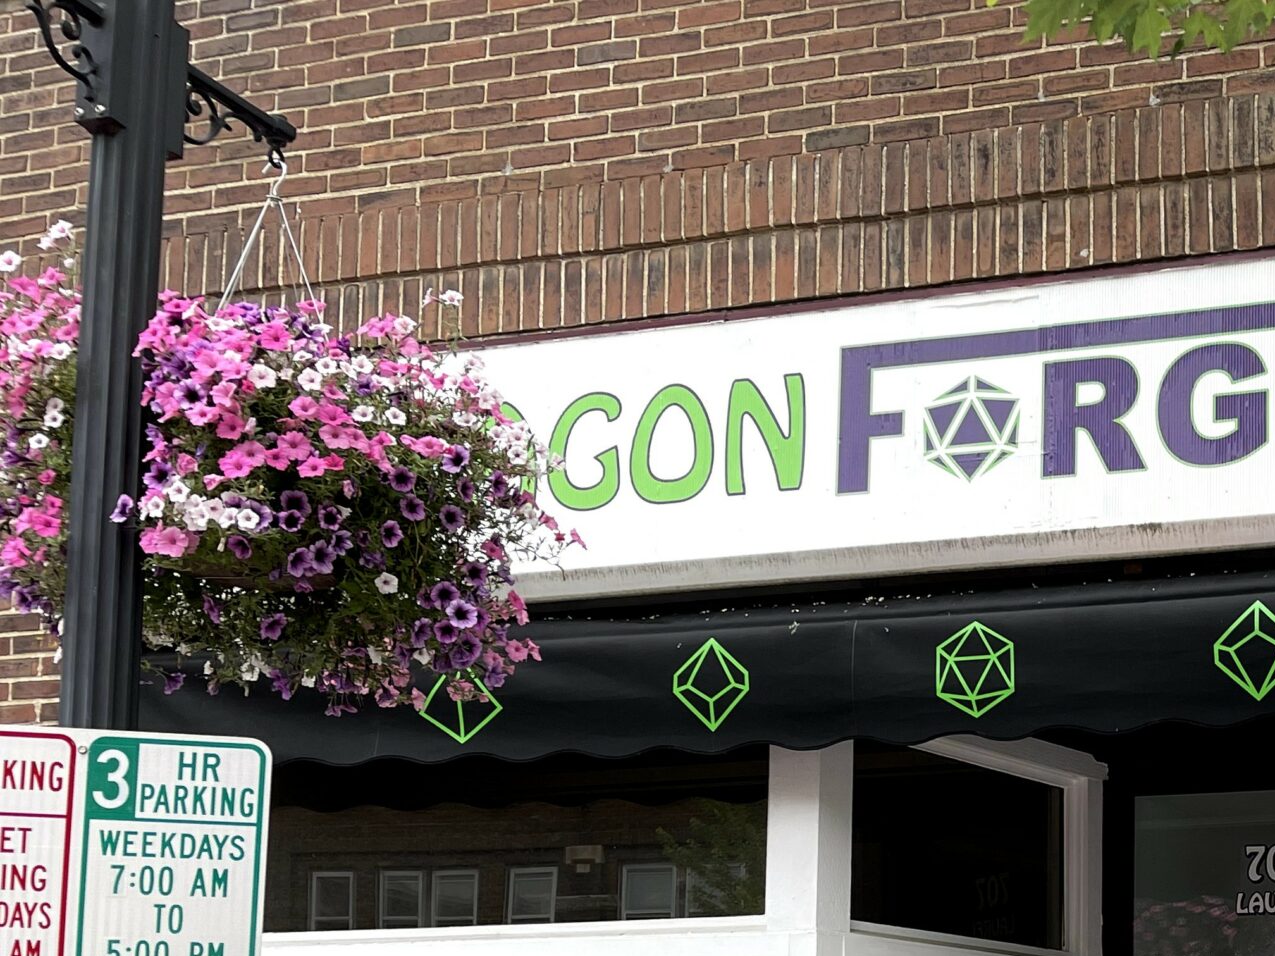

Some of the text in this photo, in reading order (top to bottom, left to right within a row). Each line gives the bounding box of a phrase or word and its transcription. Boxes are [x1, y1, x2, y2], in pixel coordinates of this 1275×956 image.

[92, 748, 221, 810] 3 HR
[139, 783, 255, 818] PARKING
[99, 829, 245, 861] WEEKDAYS
[110, 864, 229, 898] 7:00 AM
[153, 903, 184, 934] TO
